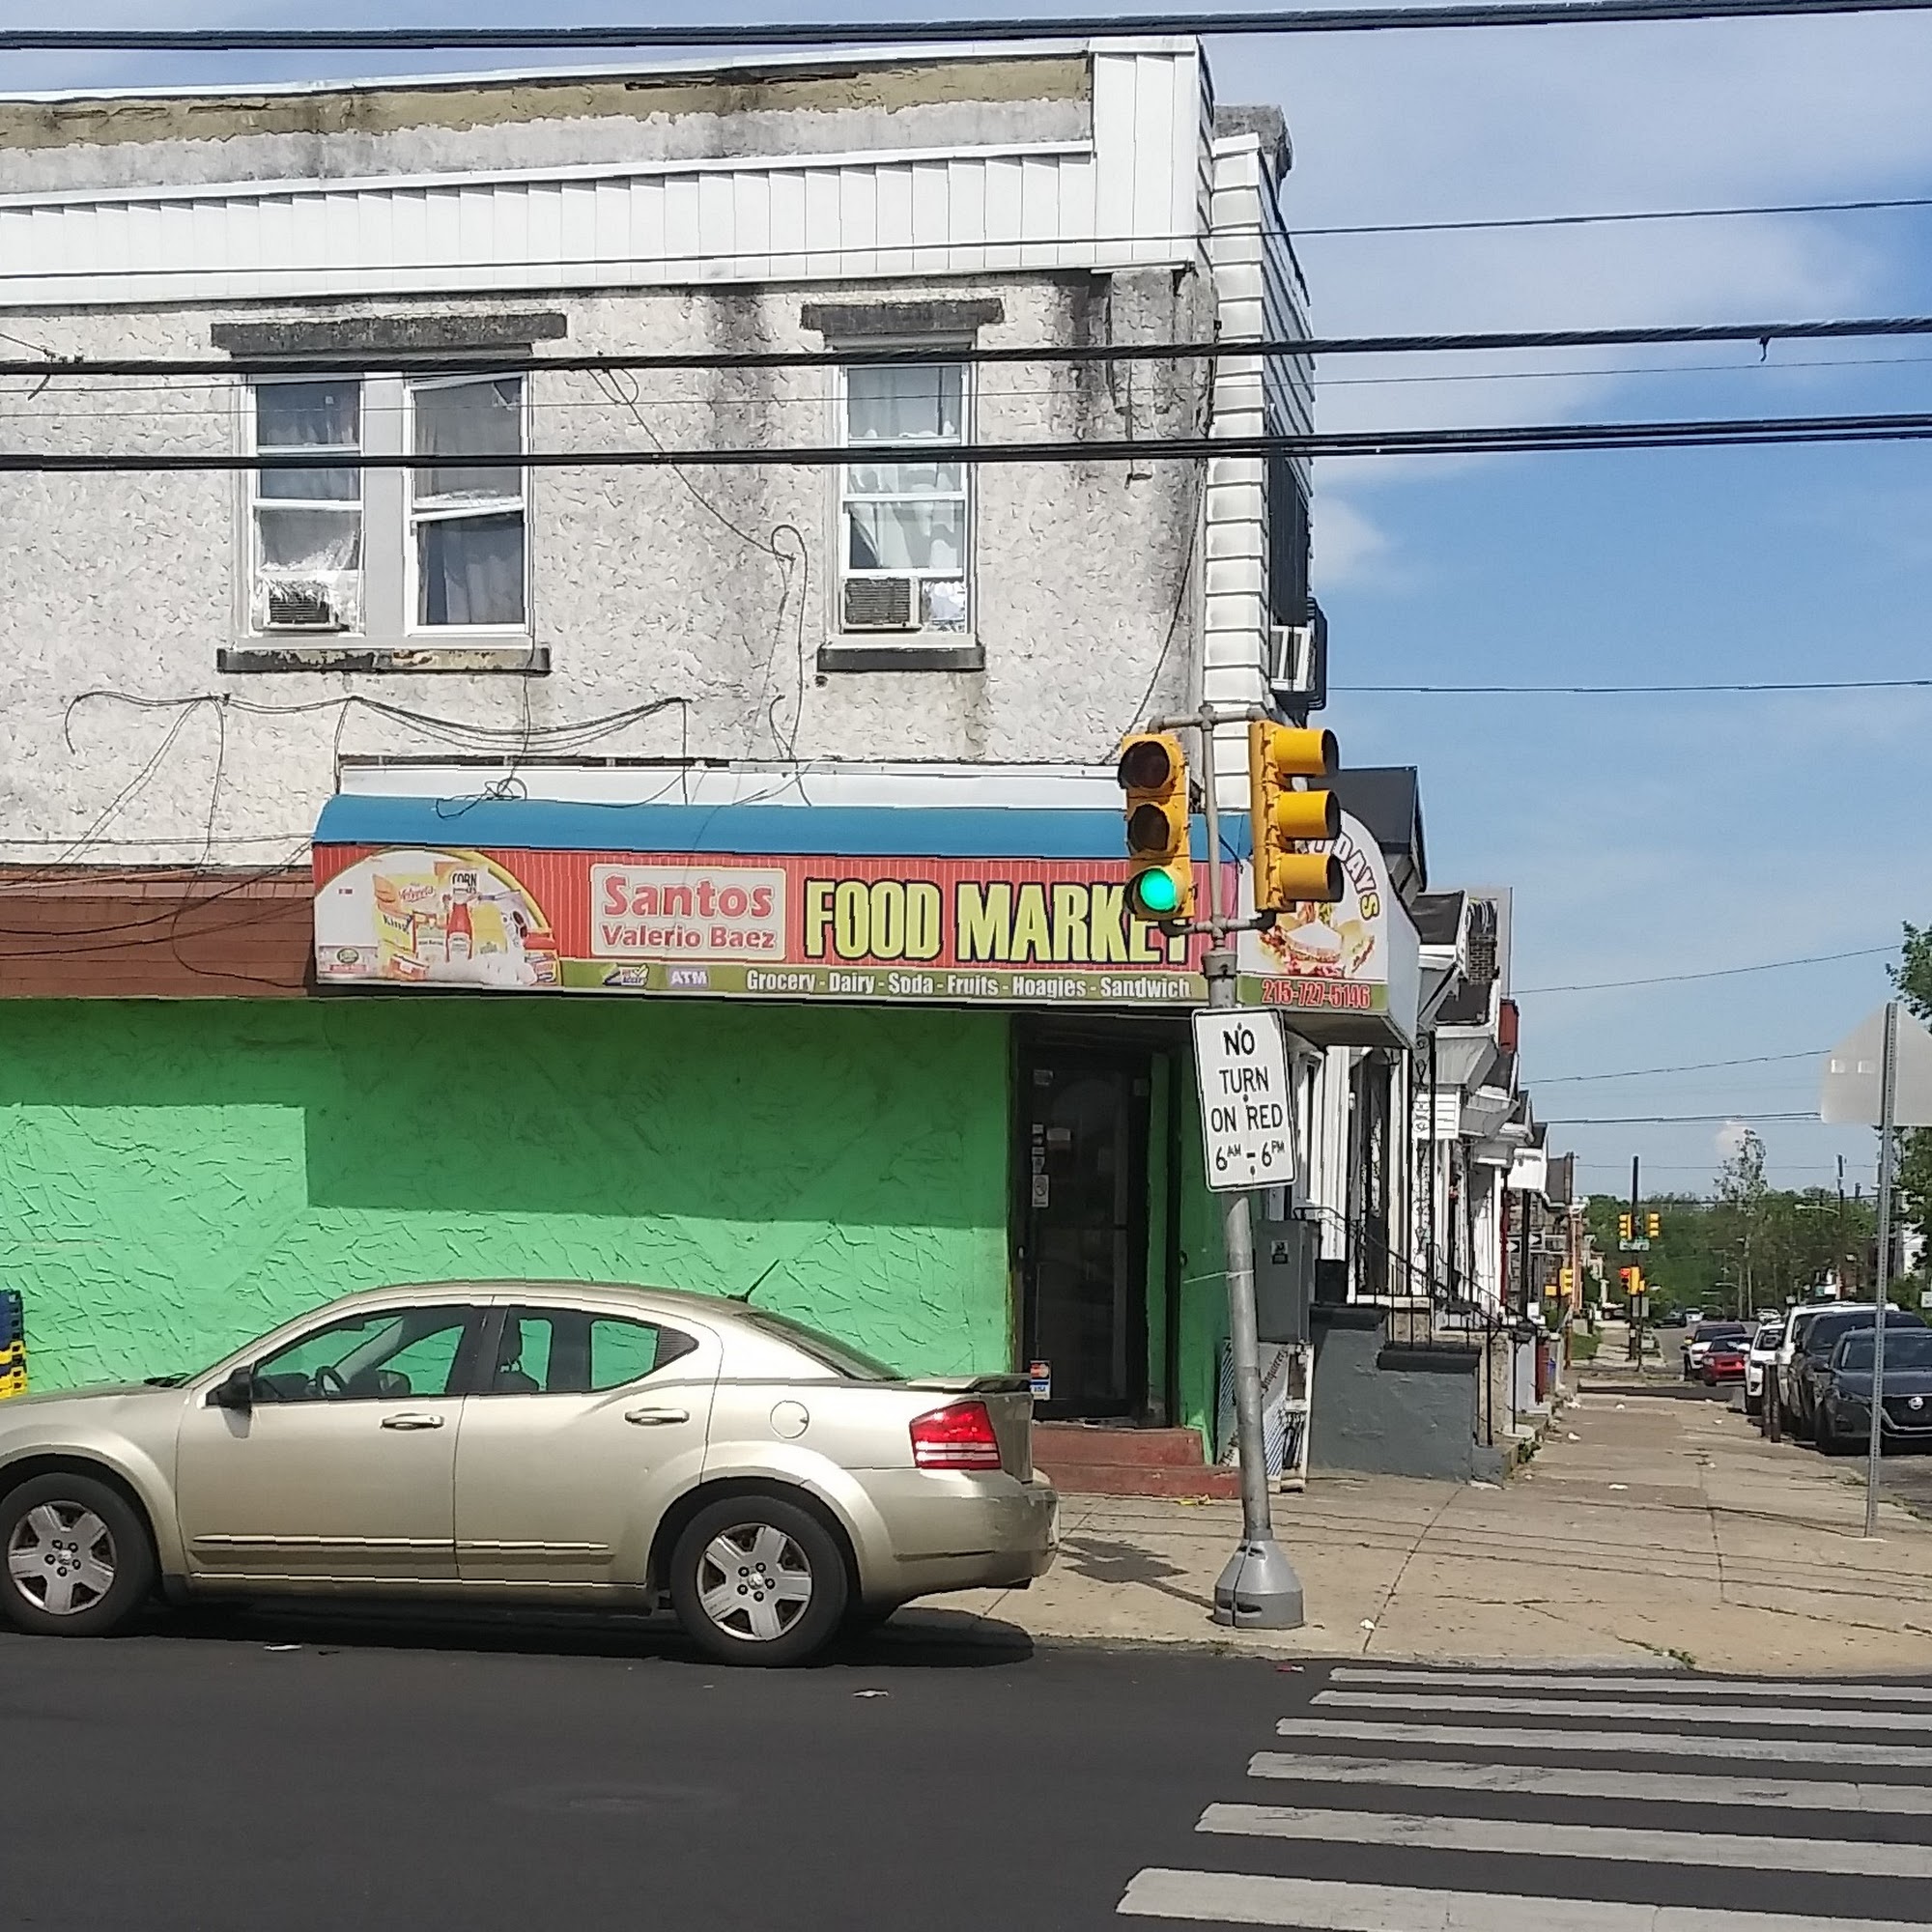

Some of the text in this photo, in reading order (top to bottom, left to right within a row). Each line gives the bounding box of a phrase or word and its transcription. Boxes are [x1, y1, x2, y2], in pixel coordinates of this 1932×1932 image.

[603, 873, 775, 918] Santos
[804, 877, 943, 962] FOOD
[600, 923, 776, 951] Valerio Baez
[670, 970, 708, 984] ATM
[746, 968, 817, 993] Grocery
[828, 971, 875, 995] Dairy
[888, 973, 934, 996] Soda
[947, 974, 999, 998] Fruits
[1011, 975, 1087, 1001] Hoagies
[1099, 976, 1191, 999] Sandwich
[1262, 979, 1372, 1009] 215-727-5146
[1222, 1029, 1256, 1056] NO
[1218, 1065, 1270, 1094] TURN
[1210, 1103, 1284, 1133] ON RED
